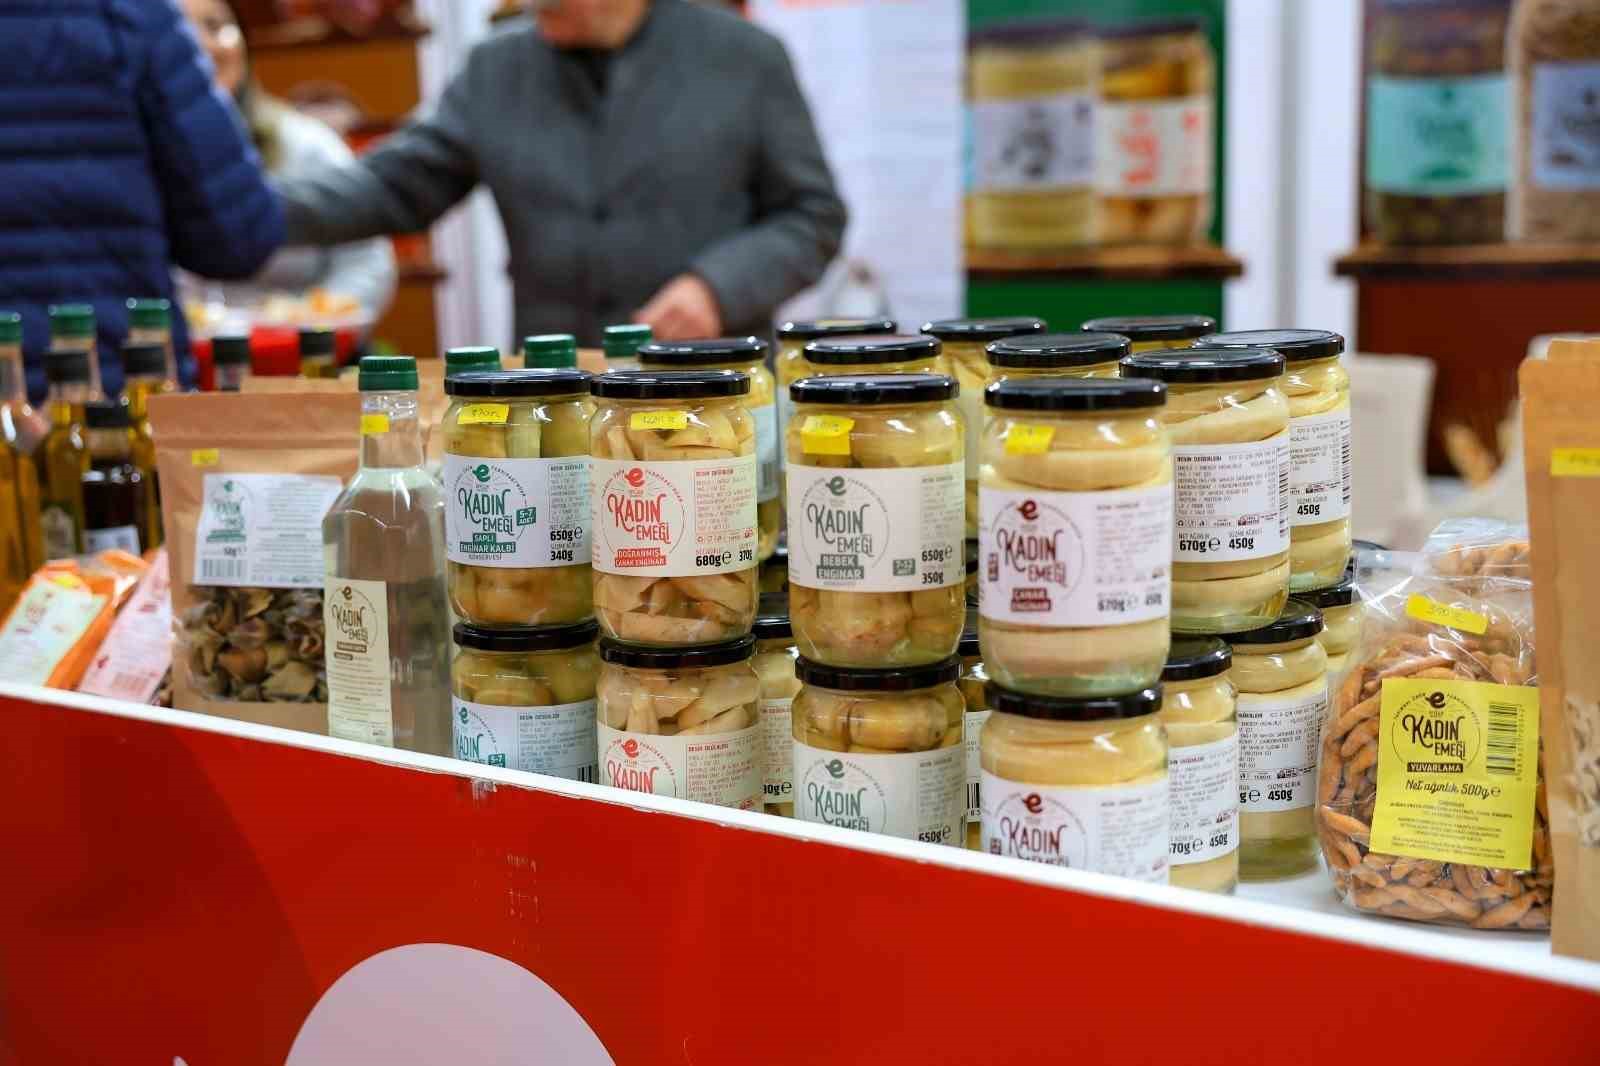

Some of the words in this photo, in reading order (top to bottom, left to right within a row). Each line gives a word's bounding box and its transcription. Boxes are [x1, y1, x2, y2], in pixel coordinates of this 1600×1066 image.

[458, 488, 511, 523] KADIN
[608, 494, 666, 531] KADIN
[1297, 504, 1320, 516] 450g
[807, 503, 870, 544] KADIN
[550, 530, 573, 542] 650g
[997, 529, 1064, 572] KADIN
[1179, 540, 1206, 553] 670g
[1229, 537, 1254, 550] 450g
[550, 550, 573, 562] 340g
[696, 555, 721, 567] 680g
[921, 549, 944, 562] 650g
[921, 572, 944, 584] 350g
[332, 604, 366, 633] KADIN
[1402, 714, 1466, 748] KADIN
[1410, 763, 1461, 772] YUVARLAMA
[1268, 789, 1293, 801] 450g
[1461, 783, 1489, 799] 500g
[808, 782, 867, 824] KADIN
[1000, 816, 1068, 859] KADIN
[1209, 833, 1228, 848] 450g
